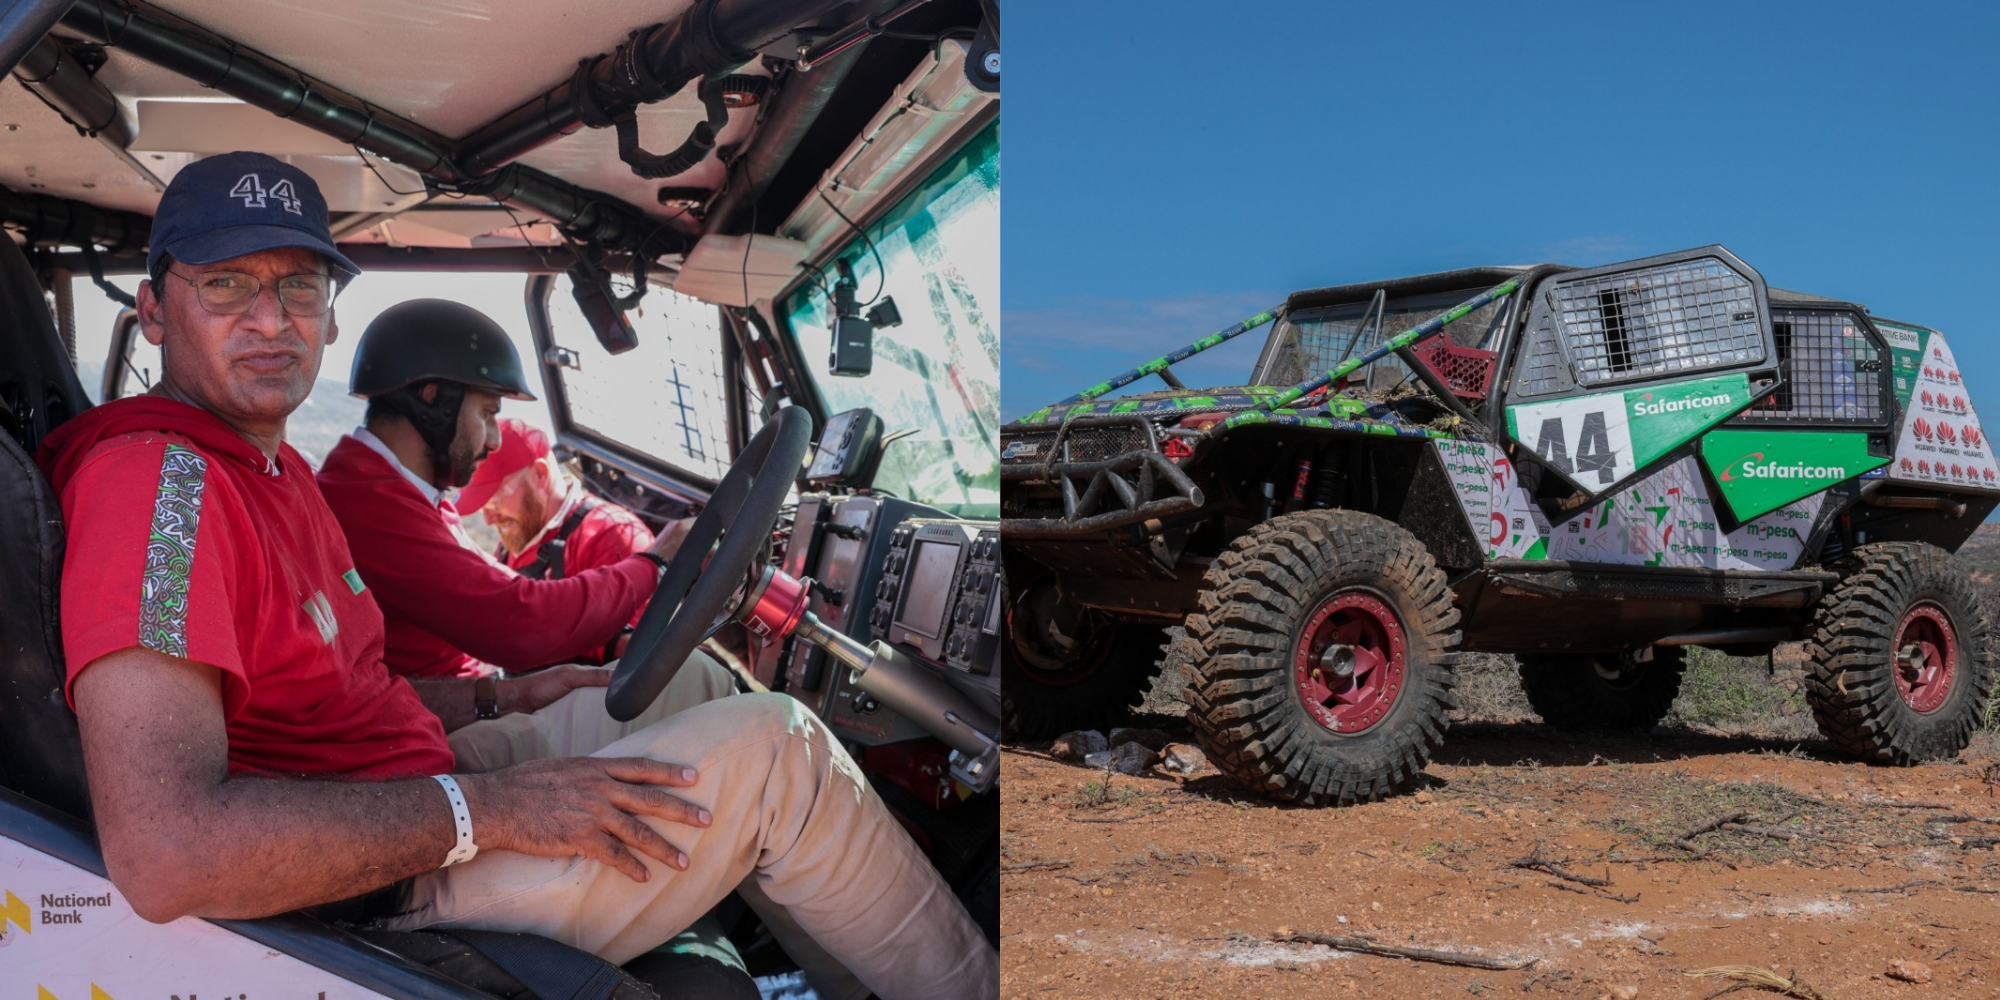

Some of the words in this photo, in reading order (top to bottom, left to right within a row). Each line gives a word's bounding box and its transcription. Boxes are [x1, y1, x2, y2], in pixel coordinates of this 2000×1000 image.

[230, 173, 302, 215] 44
[1900, 332, 1918, 343] BANK
[1633, 393, 1731, 417] Safaricom
[1536, 411, 1617, 484] 44
[1742, 461, 1846, 479] Safaricom
[41, 892, 111, 908] National
[41, 909, 83, 925] Bank
